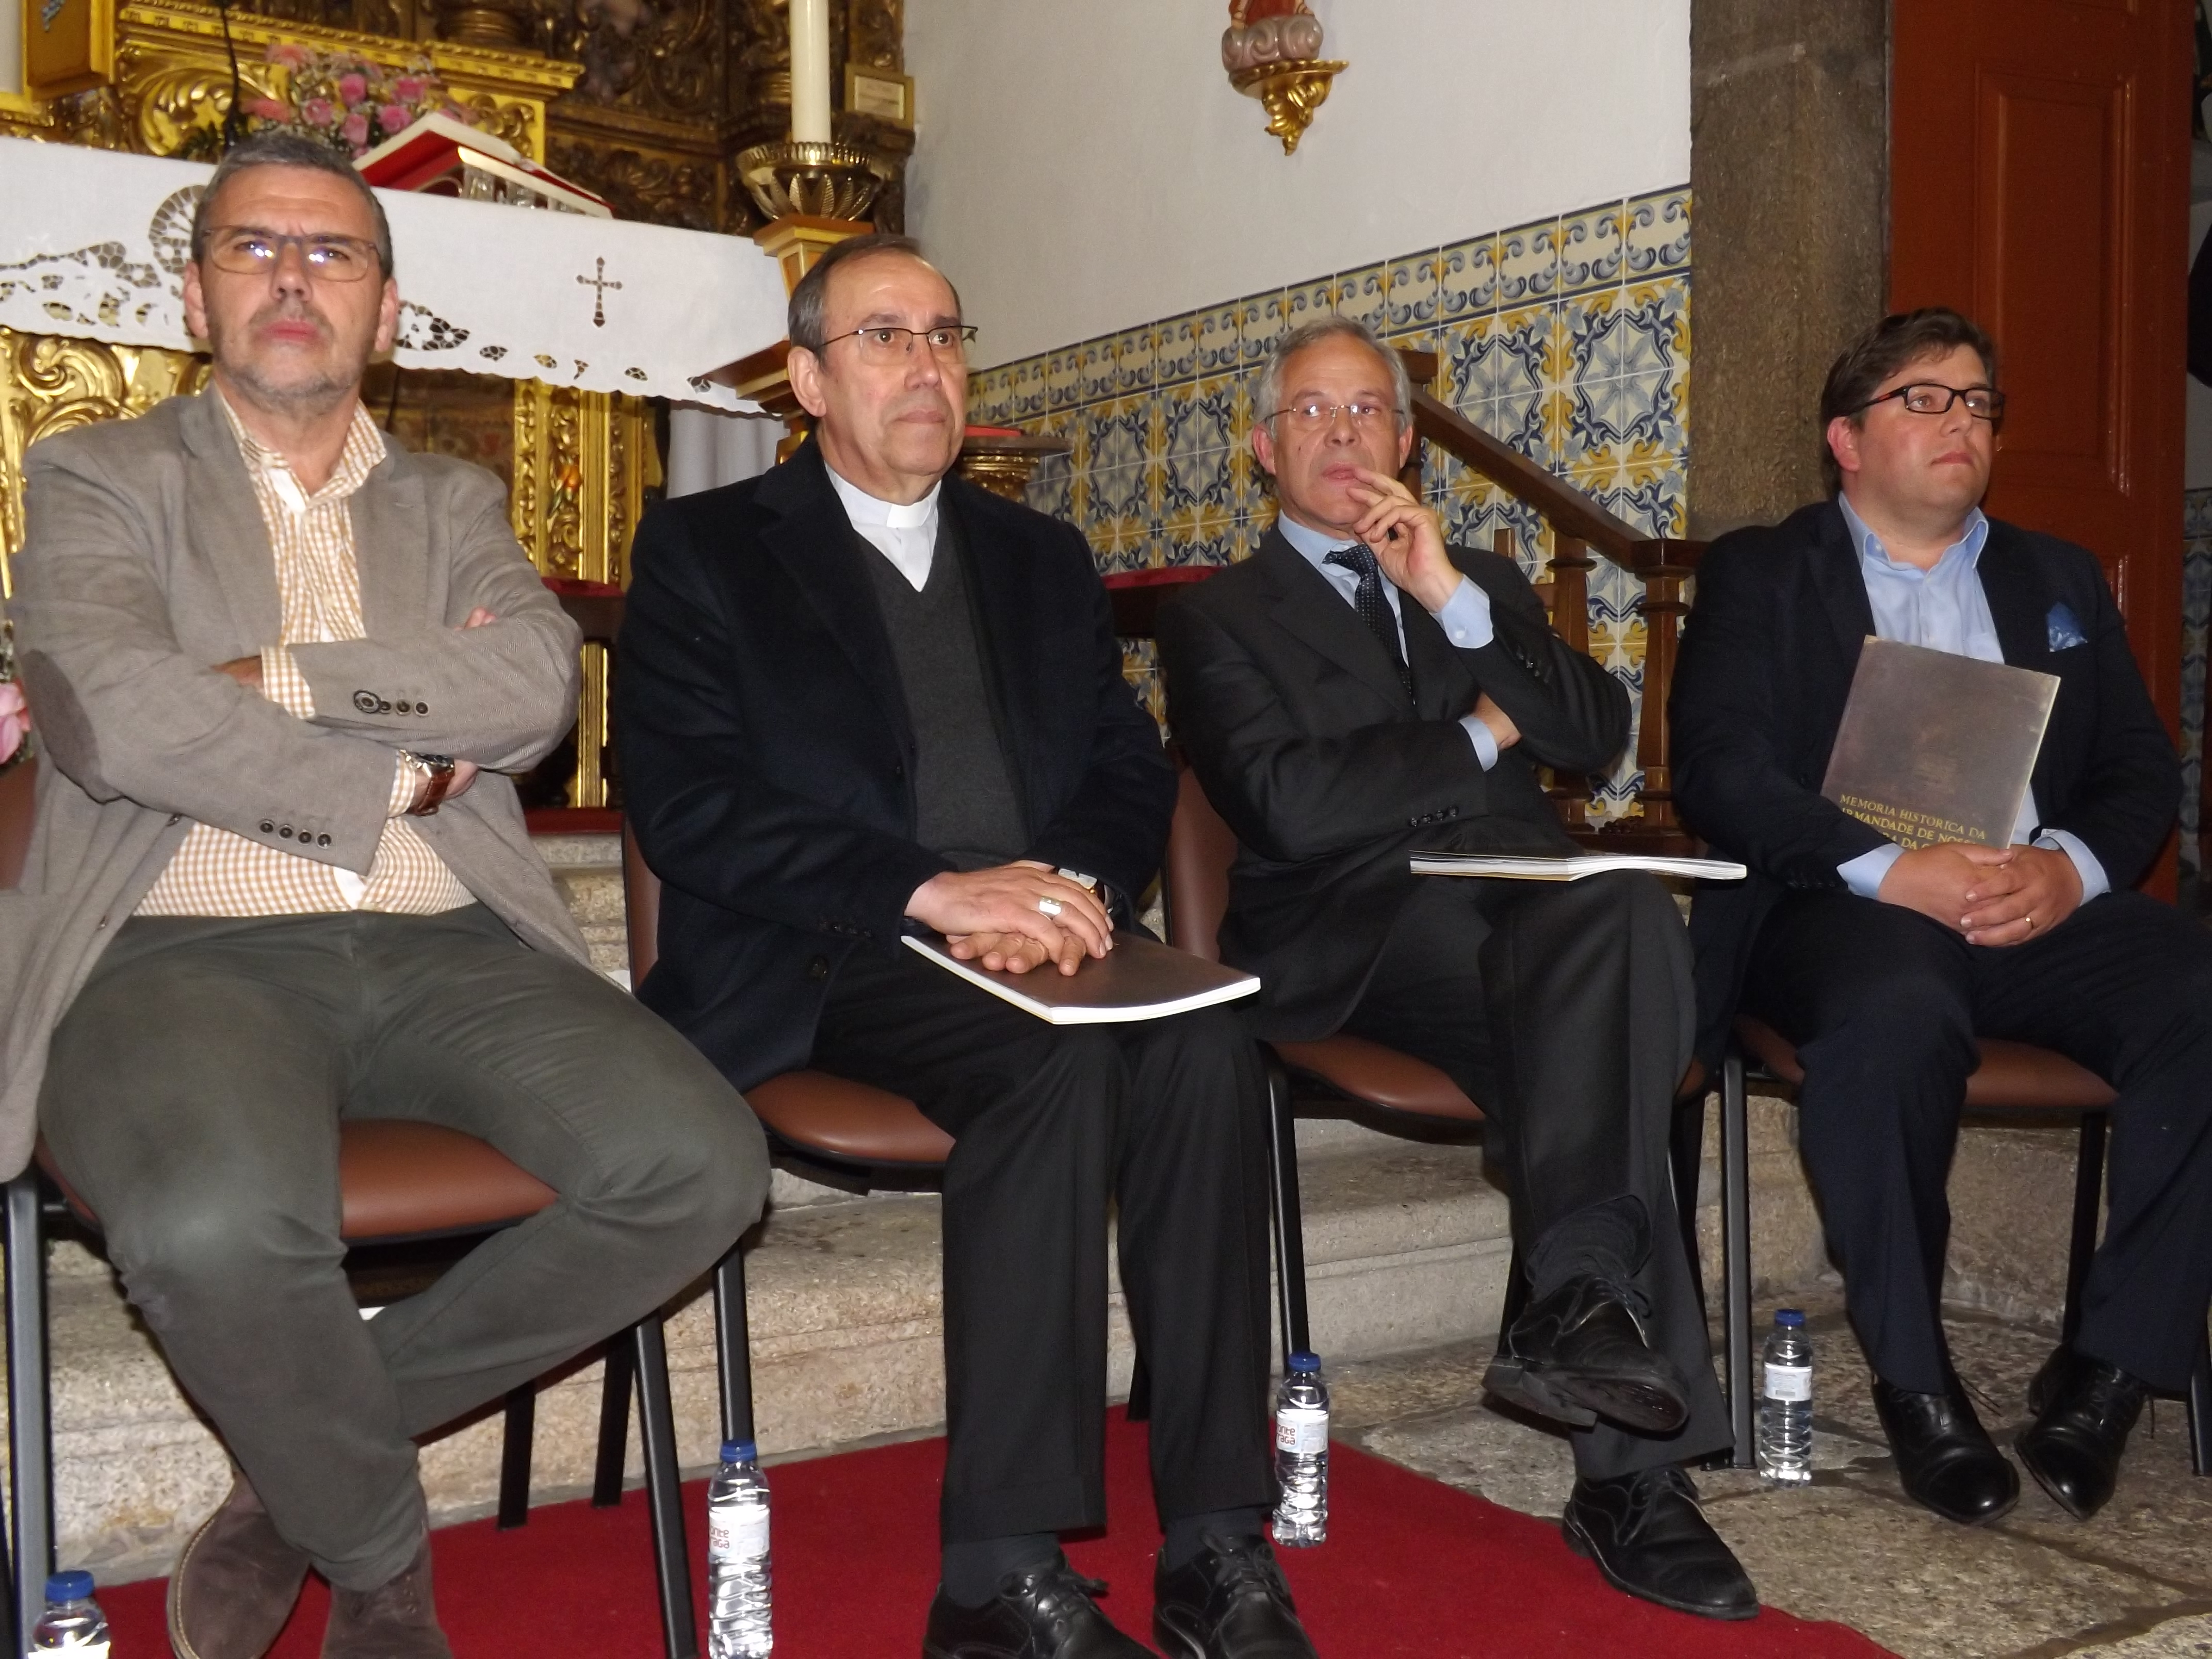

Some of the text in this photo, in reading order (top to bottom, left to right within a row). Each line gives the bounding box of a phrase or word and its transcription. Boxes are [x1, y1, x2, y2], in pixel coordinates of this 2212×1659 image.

[1917, 828, 1935, 840] DE
[1968, 827, 1986, 840] DA
[1901, 837, 1918, 851] DA
